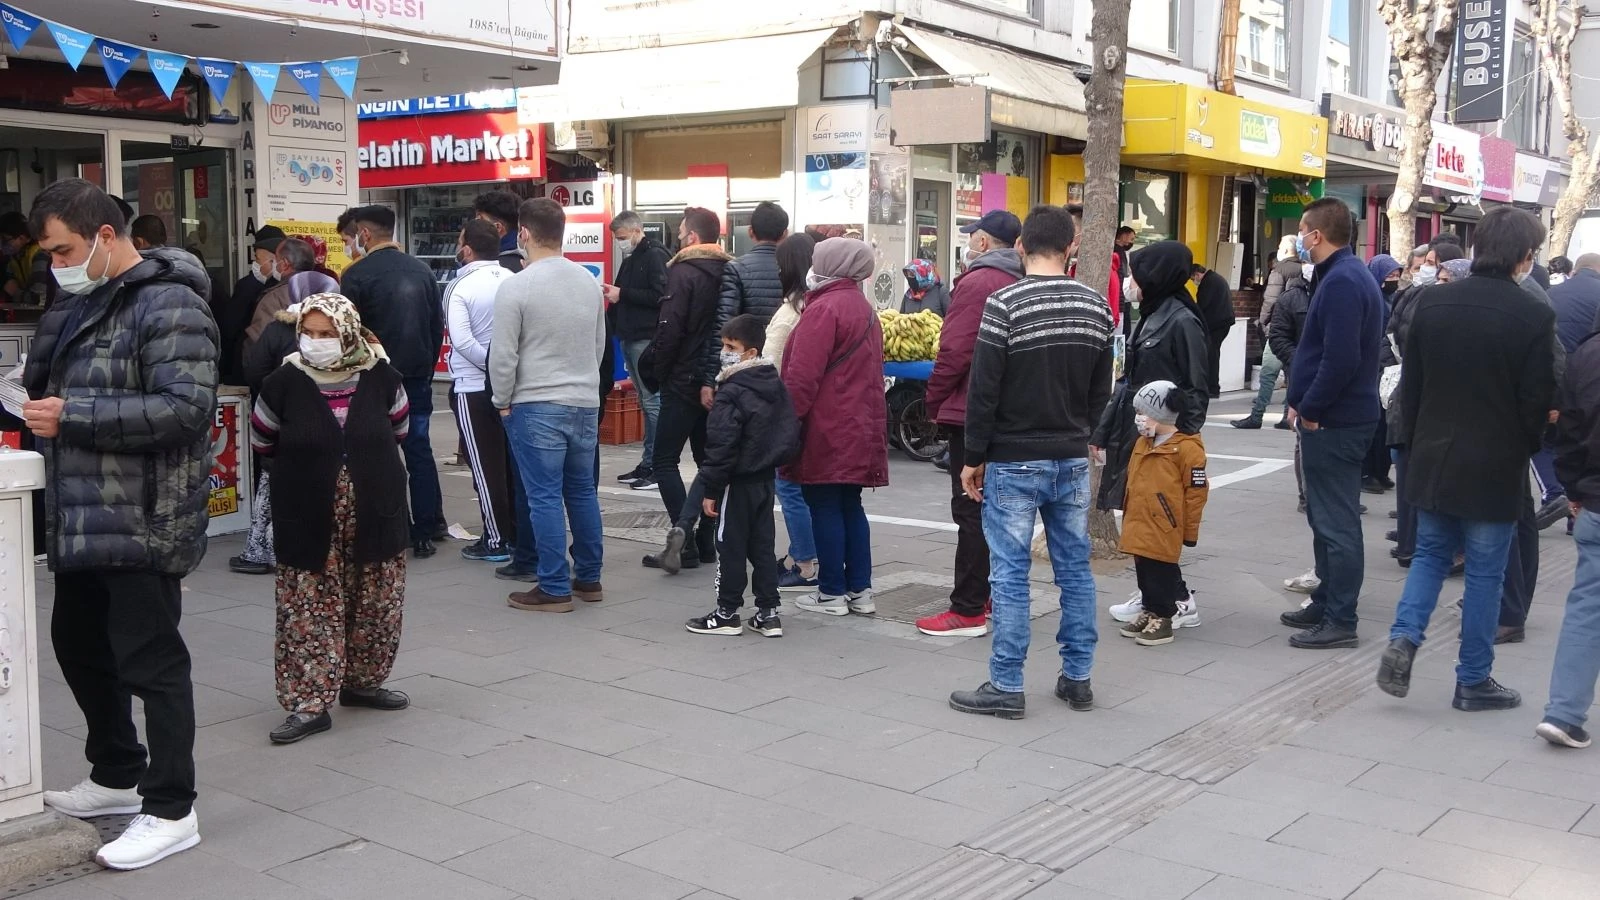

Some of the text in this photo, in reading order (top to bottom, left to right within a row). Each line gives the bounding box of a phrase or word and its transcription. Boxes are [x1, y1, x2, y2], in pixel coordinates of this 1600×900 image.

[468, 18, 511, 35] 1985'ten
[1463, 0, 1492, 87] BUSE
[292, 117, 343, 132] PİYANGO
[1335, 109, 1372, 142] FIRAT
[431, 128, 530, 165] Market
[292, 154, 330, 163] SAYISAL
[574, 190, 594, 206] LG
[566, 232, 599, 244] iPhone
